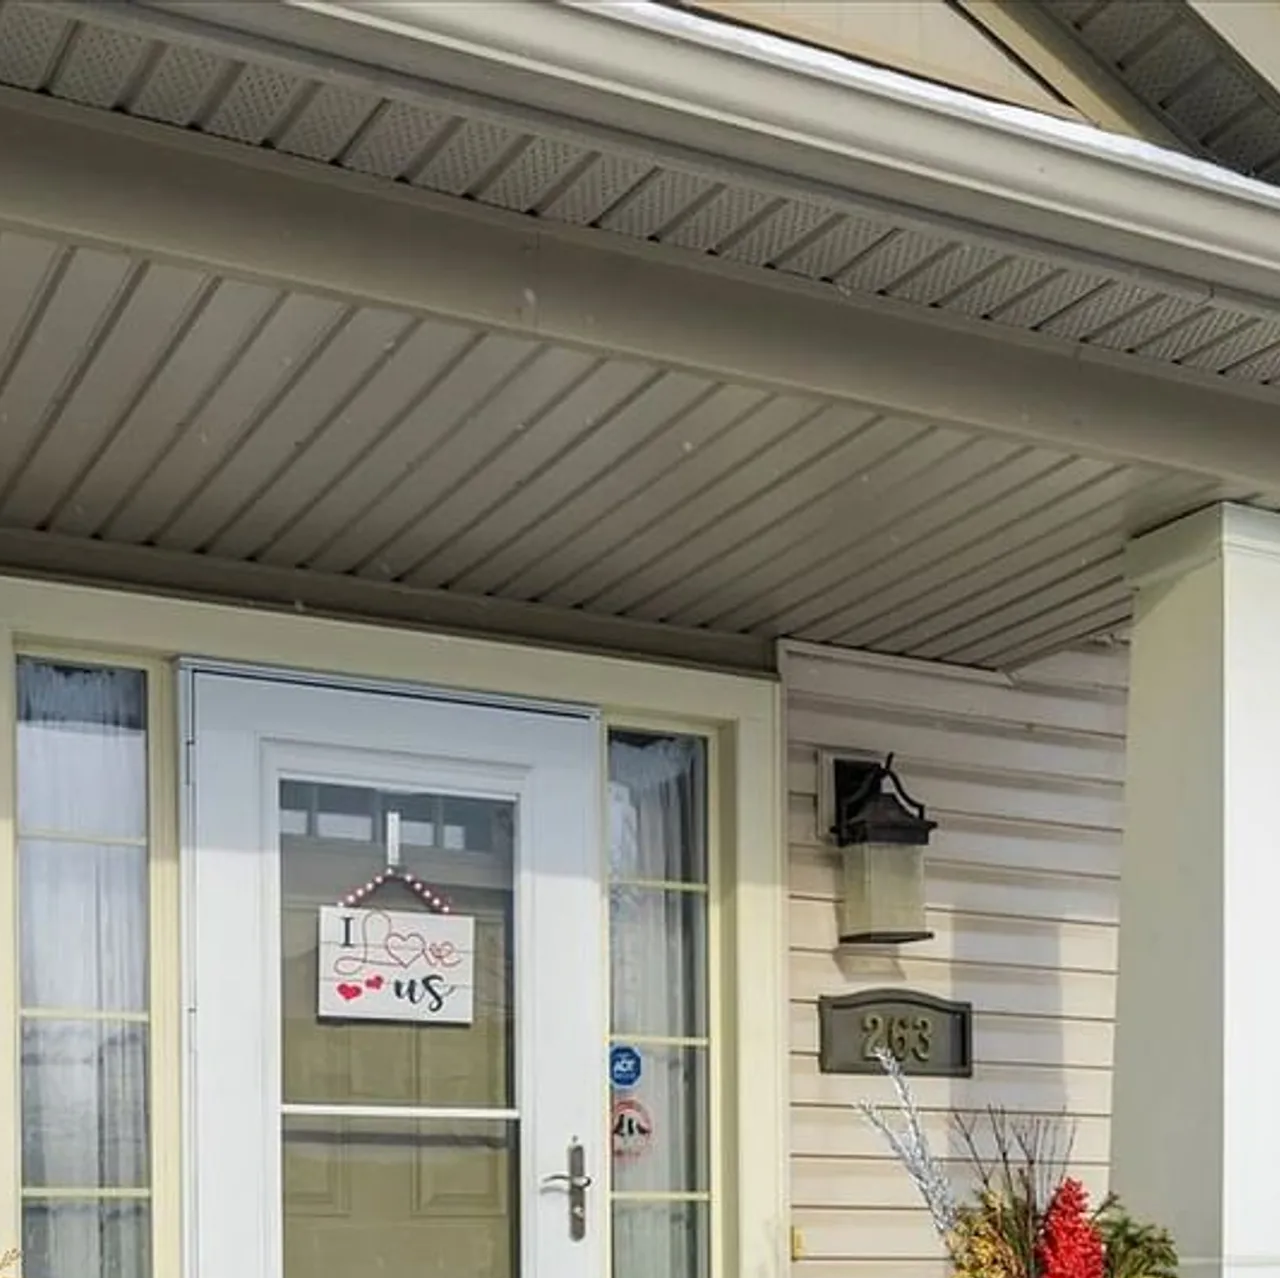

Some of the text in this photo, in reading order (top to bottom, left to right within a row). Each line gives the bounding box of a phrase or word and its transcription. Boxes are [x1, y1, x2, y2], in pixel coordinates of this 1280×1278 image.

[341, 916, 354, 947] I
[394, 974, 457, 1012] us
[861, 1014, 933, 1062] 263
